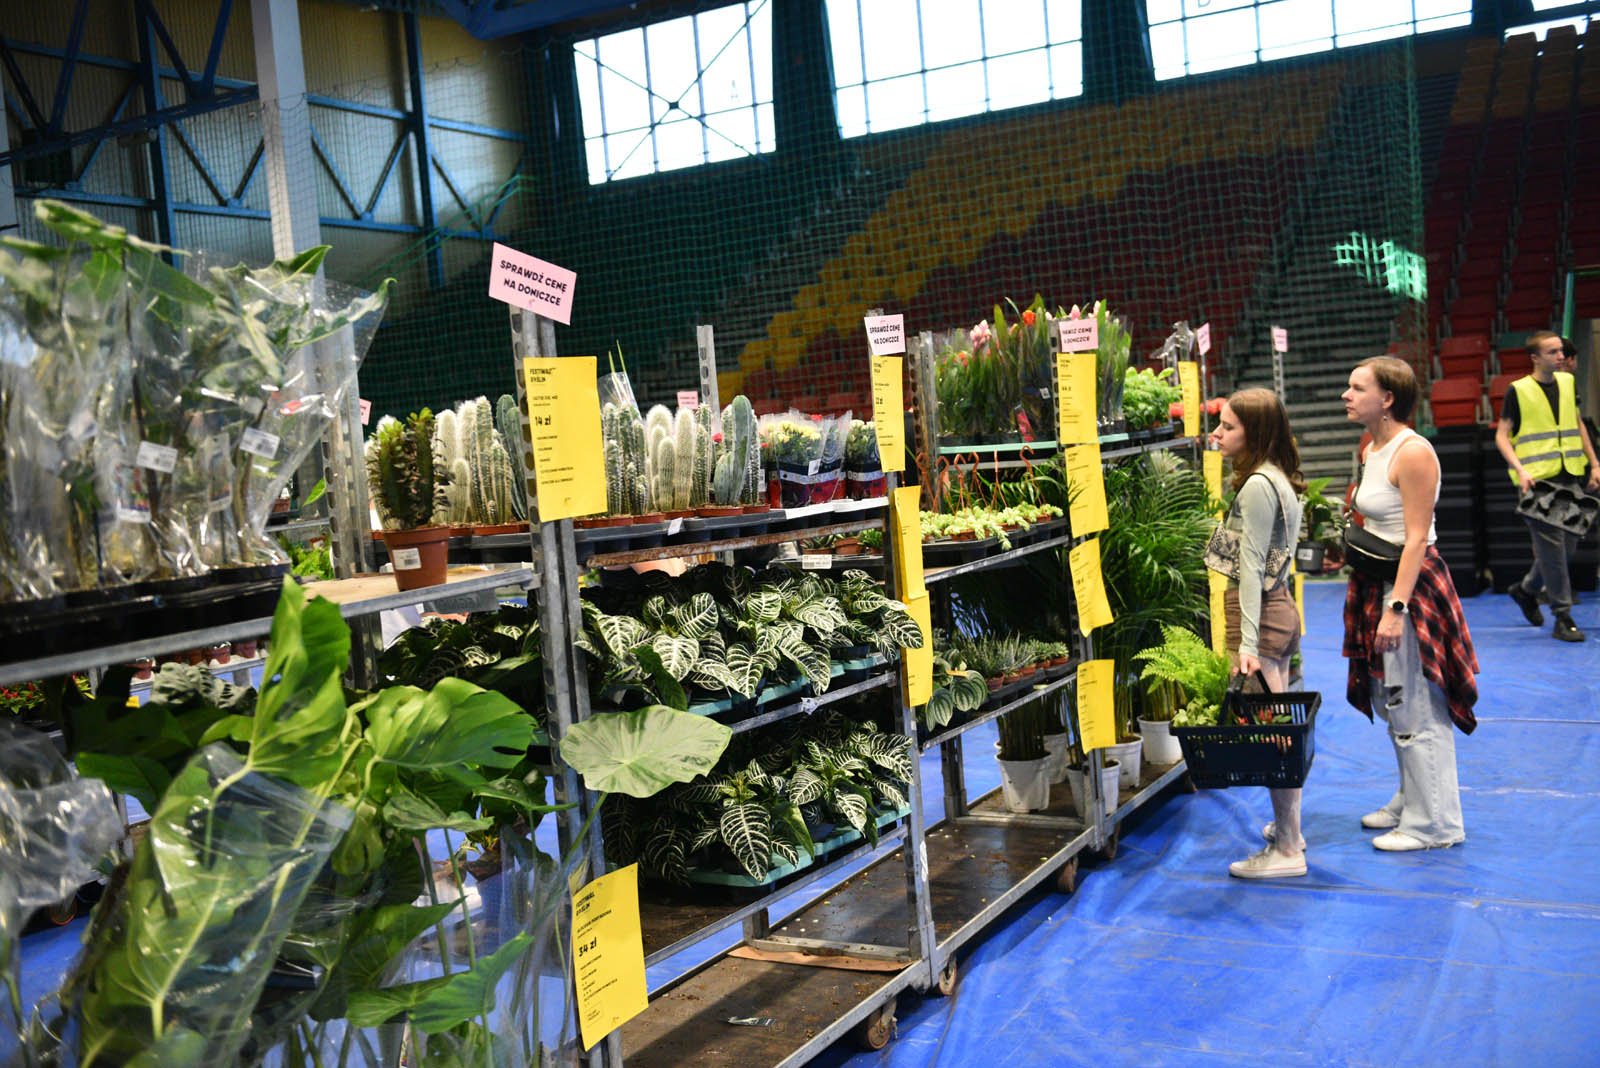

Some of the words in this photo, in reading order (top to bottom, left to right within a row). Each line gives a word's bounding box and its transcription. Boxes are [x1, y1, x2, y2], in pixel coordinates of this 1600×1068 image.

[503, 278, 516, 290] NA
[517, 283, 562, 306] DONICZCE
[544, 277, 568, 295] CENĘ
[535, 415, 543, 426] 14
[578, 944, 589, 957] 34
